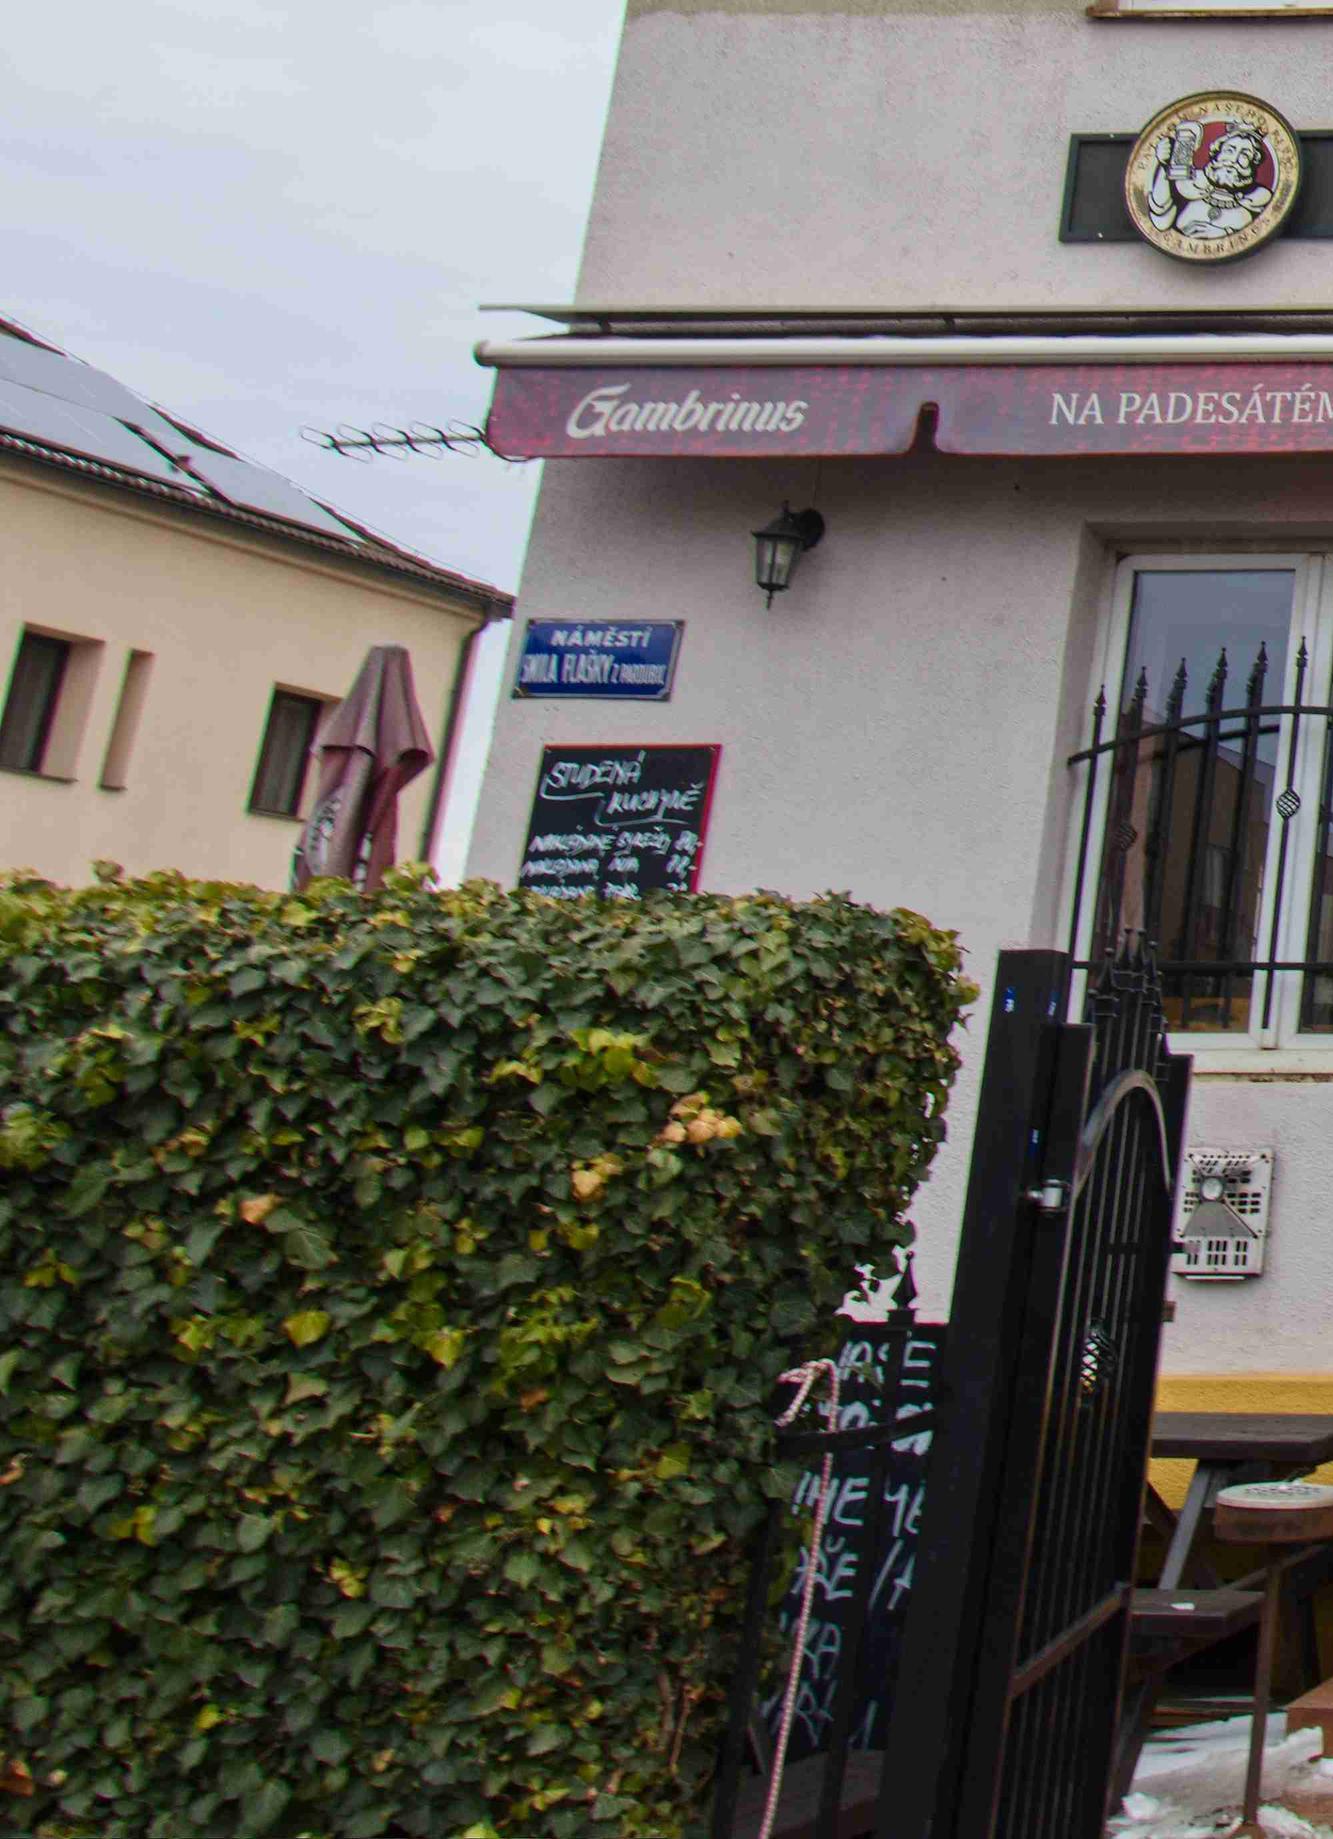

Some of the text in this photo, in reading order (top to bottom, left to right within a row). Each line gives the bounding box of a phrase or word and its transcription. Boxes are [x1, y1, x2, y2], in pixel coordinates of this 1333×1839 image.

[565, 383, 809, 438] Gambrinus
[1048, 392, 1104, 425] NA
[551, 624, 653, 647] NÁMĚSTÍ
[547, 750, 647, 788] STUDENÁ
[605, 782, 705, 819] KUCHYNĚ
